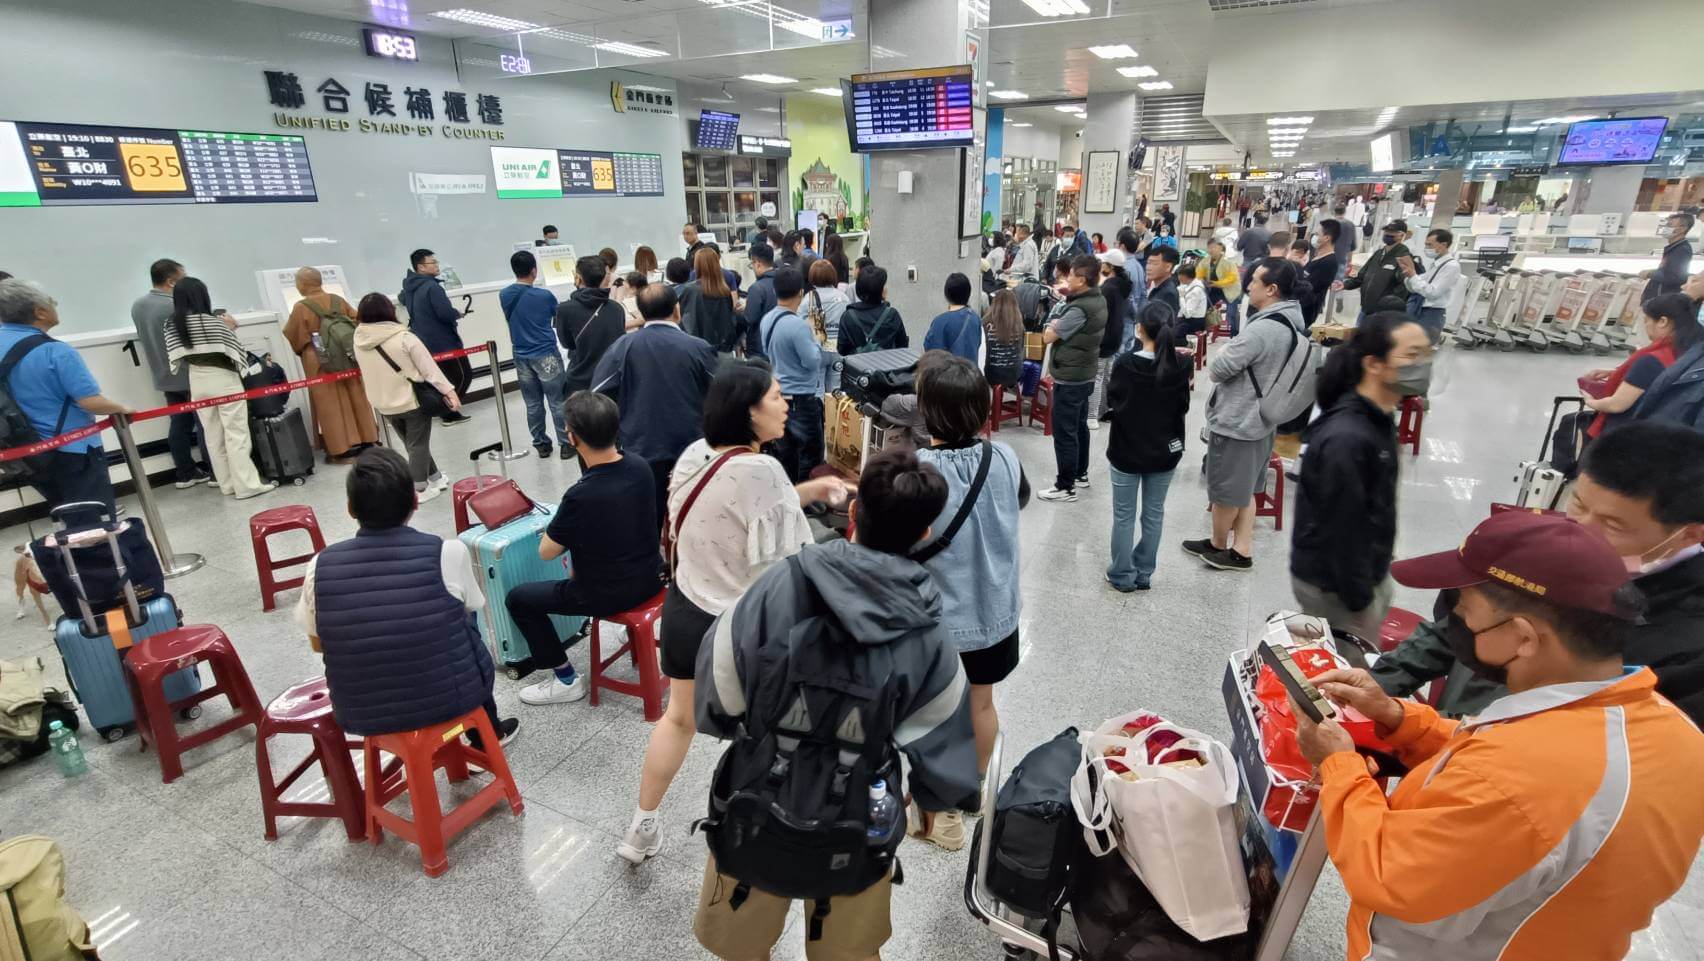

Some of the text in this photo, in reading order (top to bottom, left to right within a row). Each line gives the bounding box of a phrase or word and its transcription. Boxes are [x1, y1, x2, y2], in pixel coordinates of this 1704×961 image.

[273, 112, 350, 131] UNIFIED
[443, 124, 504, 141] COUNTER
[128, 155, 181, 178] 635
[502, 163, 520, 171] UNI
[593, 167, 613, 182] 635
[122, 340, 141, 366] 1
